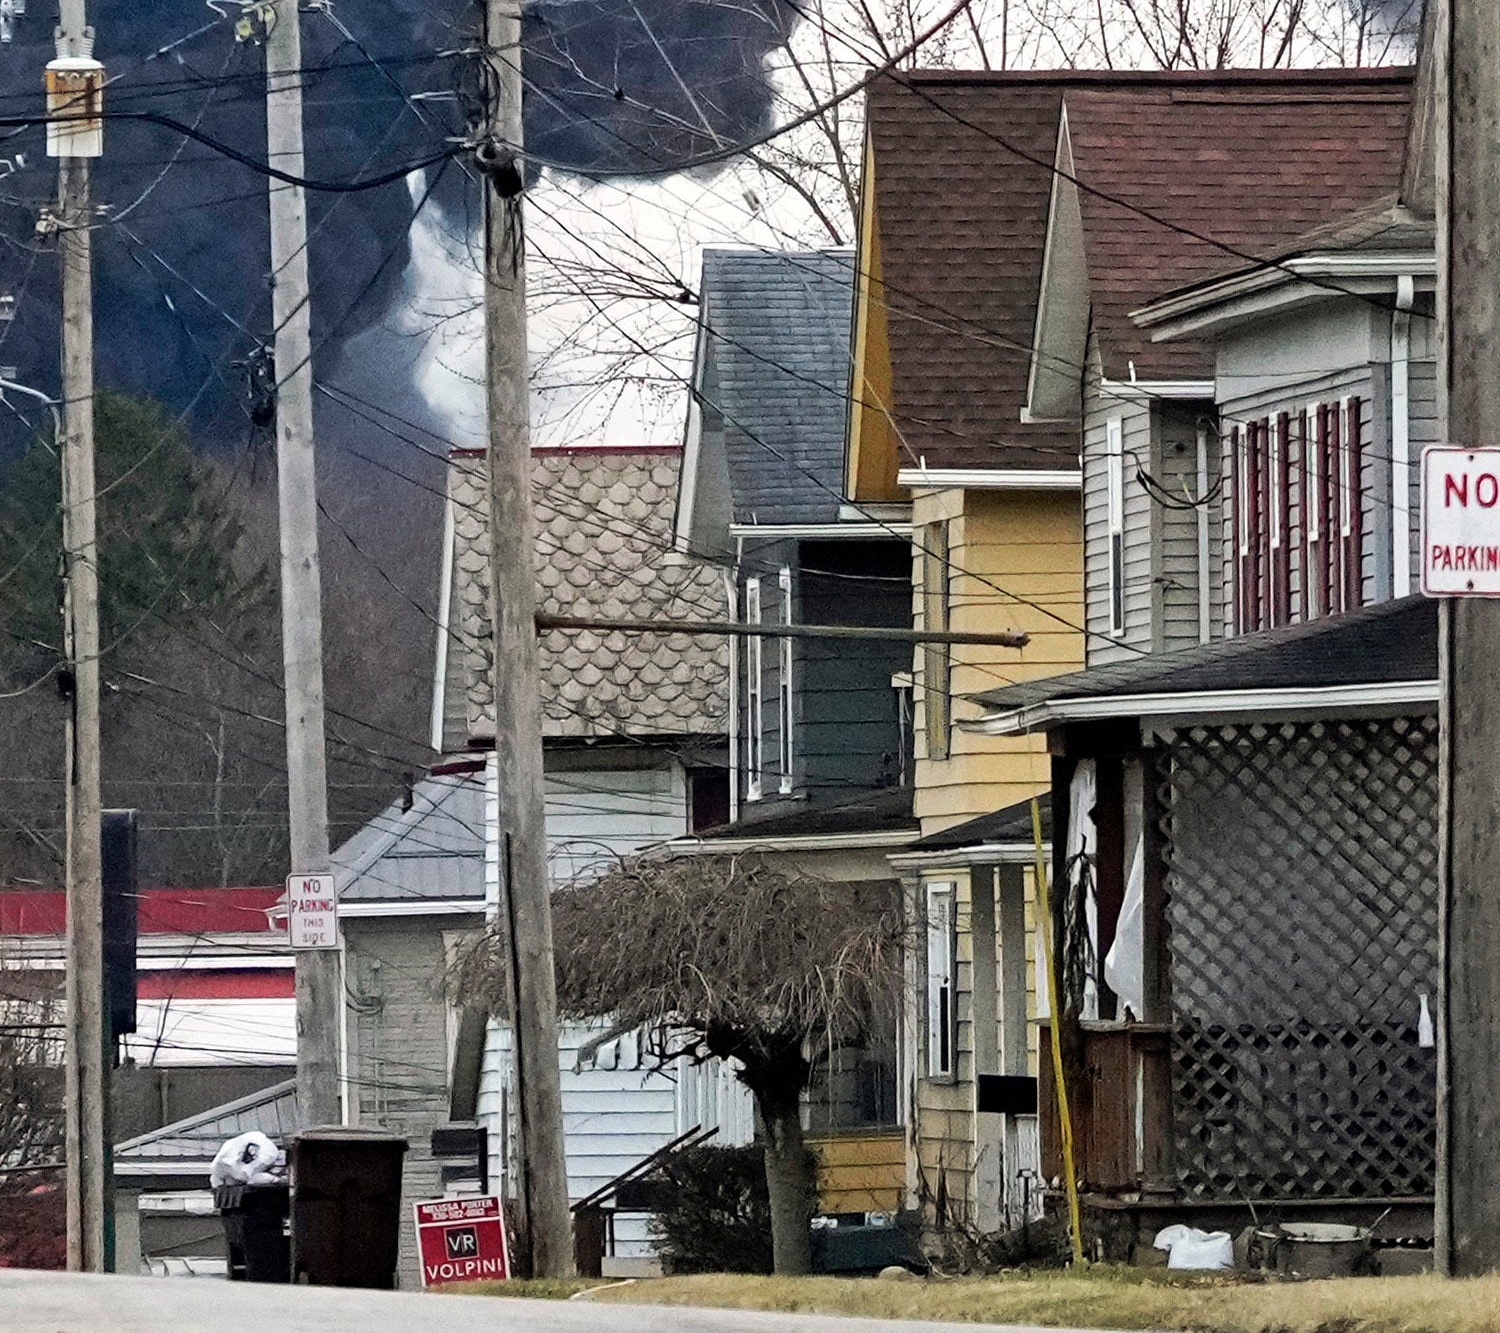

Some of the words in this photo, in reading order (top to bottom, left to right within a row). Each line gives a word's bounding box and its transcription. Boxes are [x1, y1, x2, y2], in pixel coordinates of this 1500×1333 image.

[1444, 473, 1499, 508] NO
[302, 879, 321, 893] NO
[291, 899, 334, 913] PARKING
[303, 918, 324, 928] THIS
[448, 1234, 475, 1251] VR
[426, 1257, 502, 1280] VOLPINI
